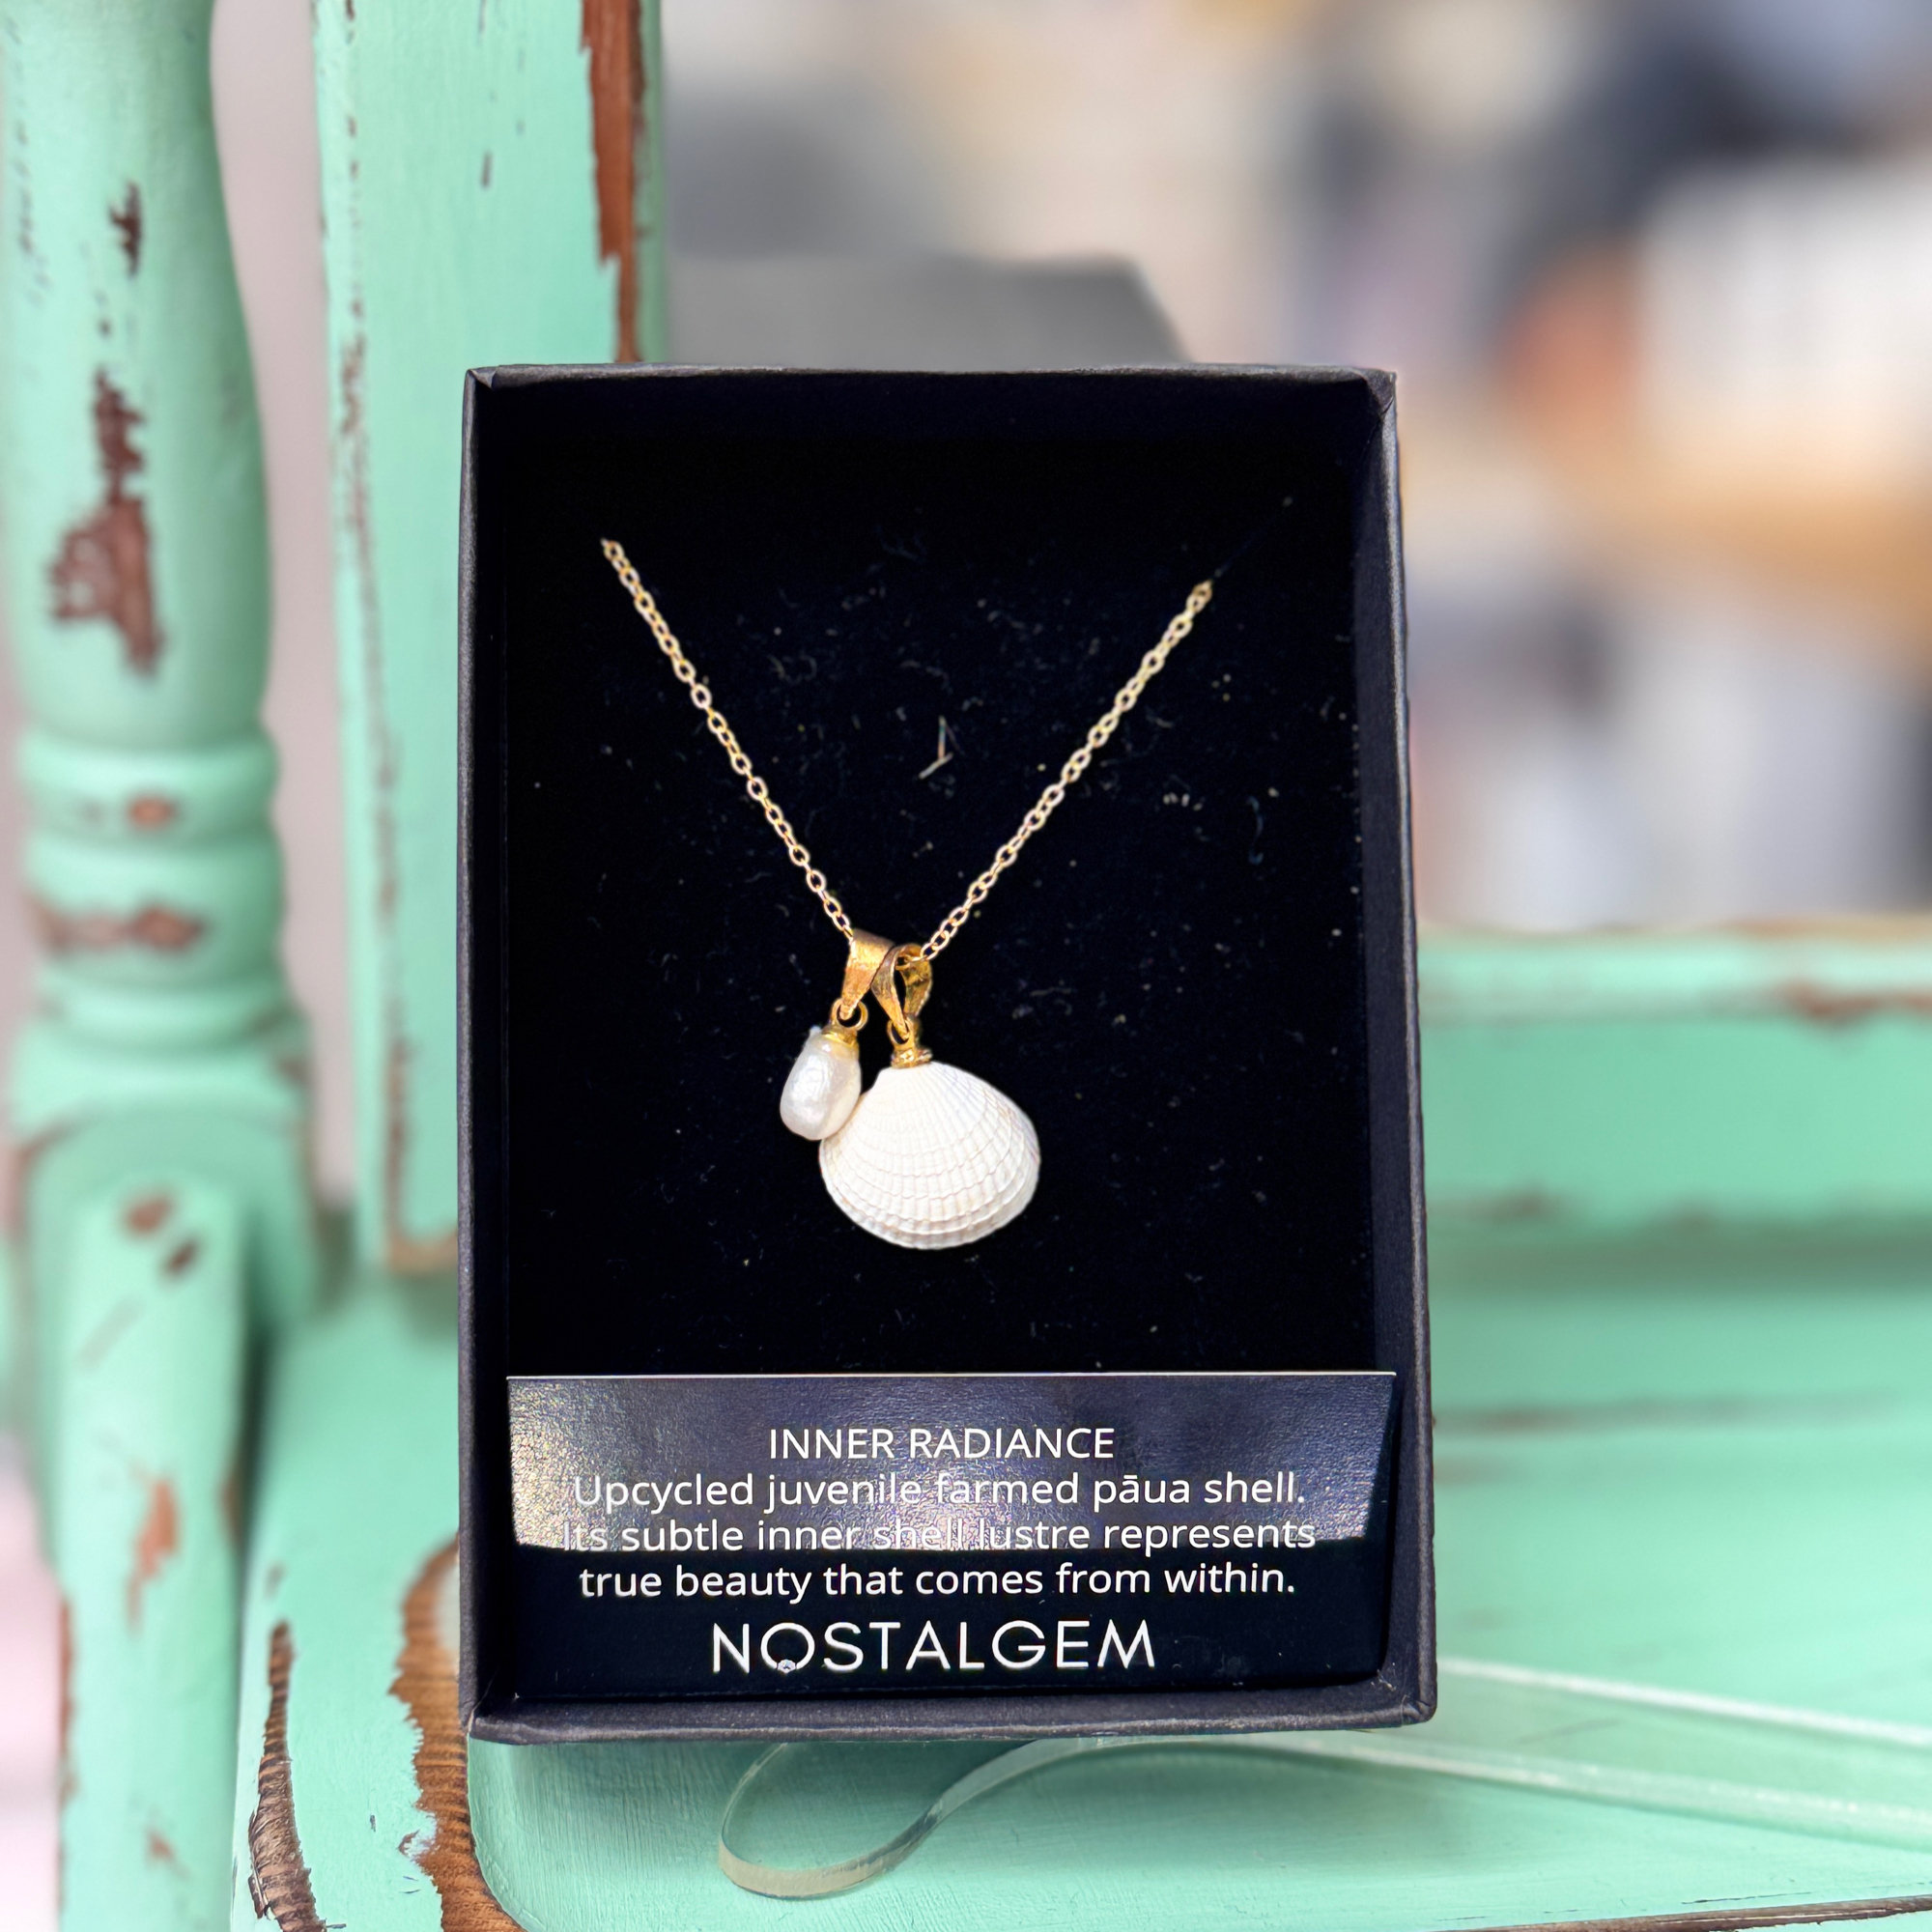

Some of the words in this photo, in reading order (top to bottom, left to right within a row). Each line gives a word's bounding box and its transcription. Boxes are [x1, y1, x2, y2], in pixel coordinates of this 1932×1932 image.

[770, 1428, 895, 1460] INNER
[910, 1428, 1116, 1459] RADIANCE
[575, 1472, 753, 1515] Upcycled
[763, 1472, 922, 1514] juvenile
[937, 1471, 1079, 1504] farmed
[1094, 1474, 1190, 1513] pāua
[1204, 1471, 1305, 1504] shell.
[563, 1521, 607, 1551] Its
[621, 1519, 744, 1551] subtle
[757, 1520, 862, 1550] inner
[872, 1518, 964, 1550] shell
[979, 1519, 1091, 1549] lustre
[1104, 1520, 1317, 1557] represents
[580, 1569, 662, 1598] true
[675, 1564, 811, 1605] beauty
[822, 1563, 903, 1595] that
[915, 1569, 1043, 1595] comes
[1055, 1562, 1151, 1594] from
[1164, 1562, 1294, 1594] within.
[712, 1619, 1155, 1674] NOSTALGEM
